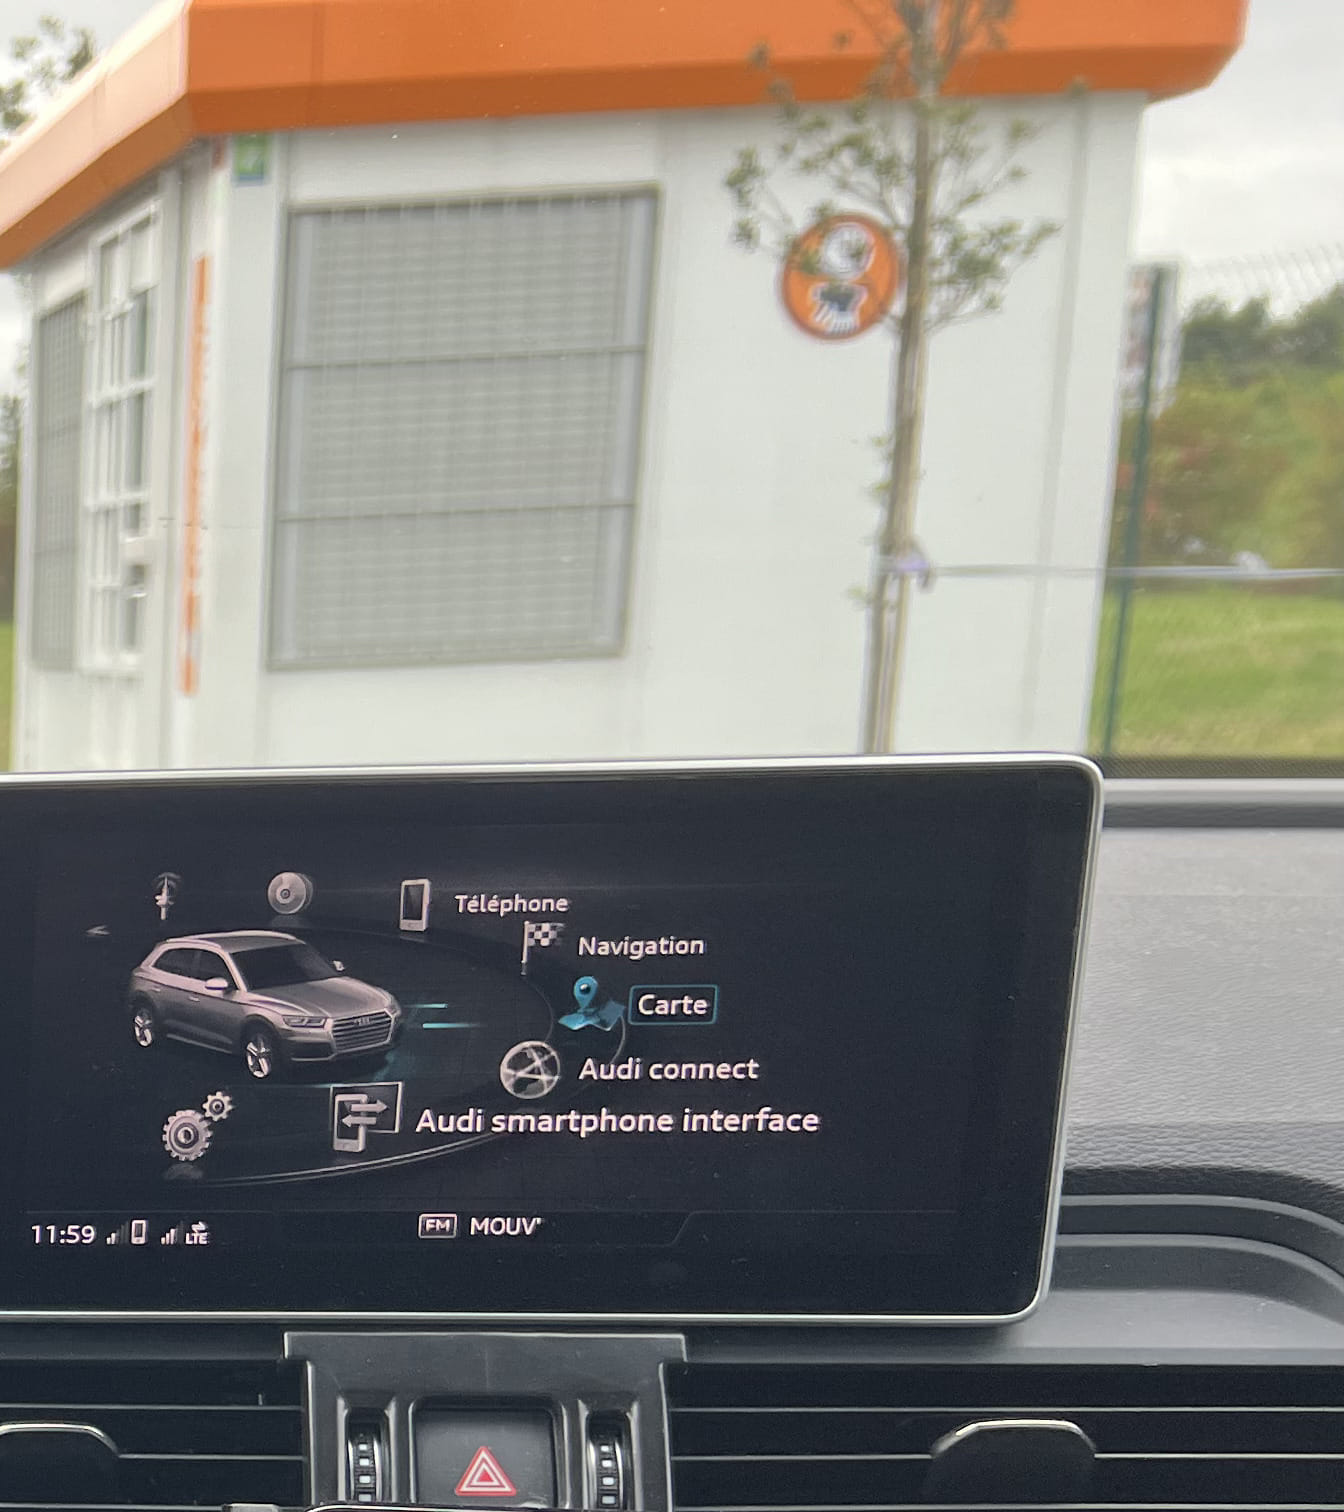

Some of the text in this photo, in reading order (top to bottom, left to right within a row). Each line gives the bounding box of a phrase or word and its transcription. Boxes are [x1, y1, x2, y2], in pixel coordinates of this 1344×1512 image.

[455, 892, 569, 916] Téléphone
[578, 936, 705, 960] Navigation
[637, 994, 708, 1017] Carte
[579, 1057, 759, 1080] Audi connect
[415, 1107, 821, 1137] Audi smartphone interface
[30, 1223, 209, 1246] 11:59 LTE
[424, 1218, 451, 1234] FM
